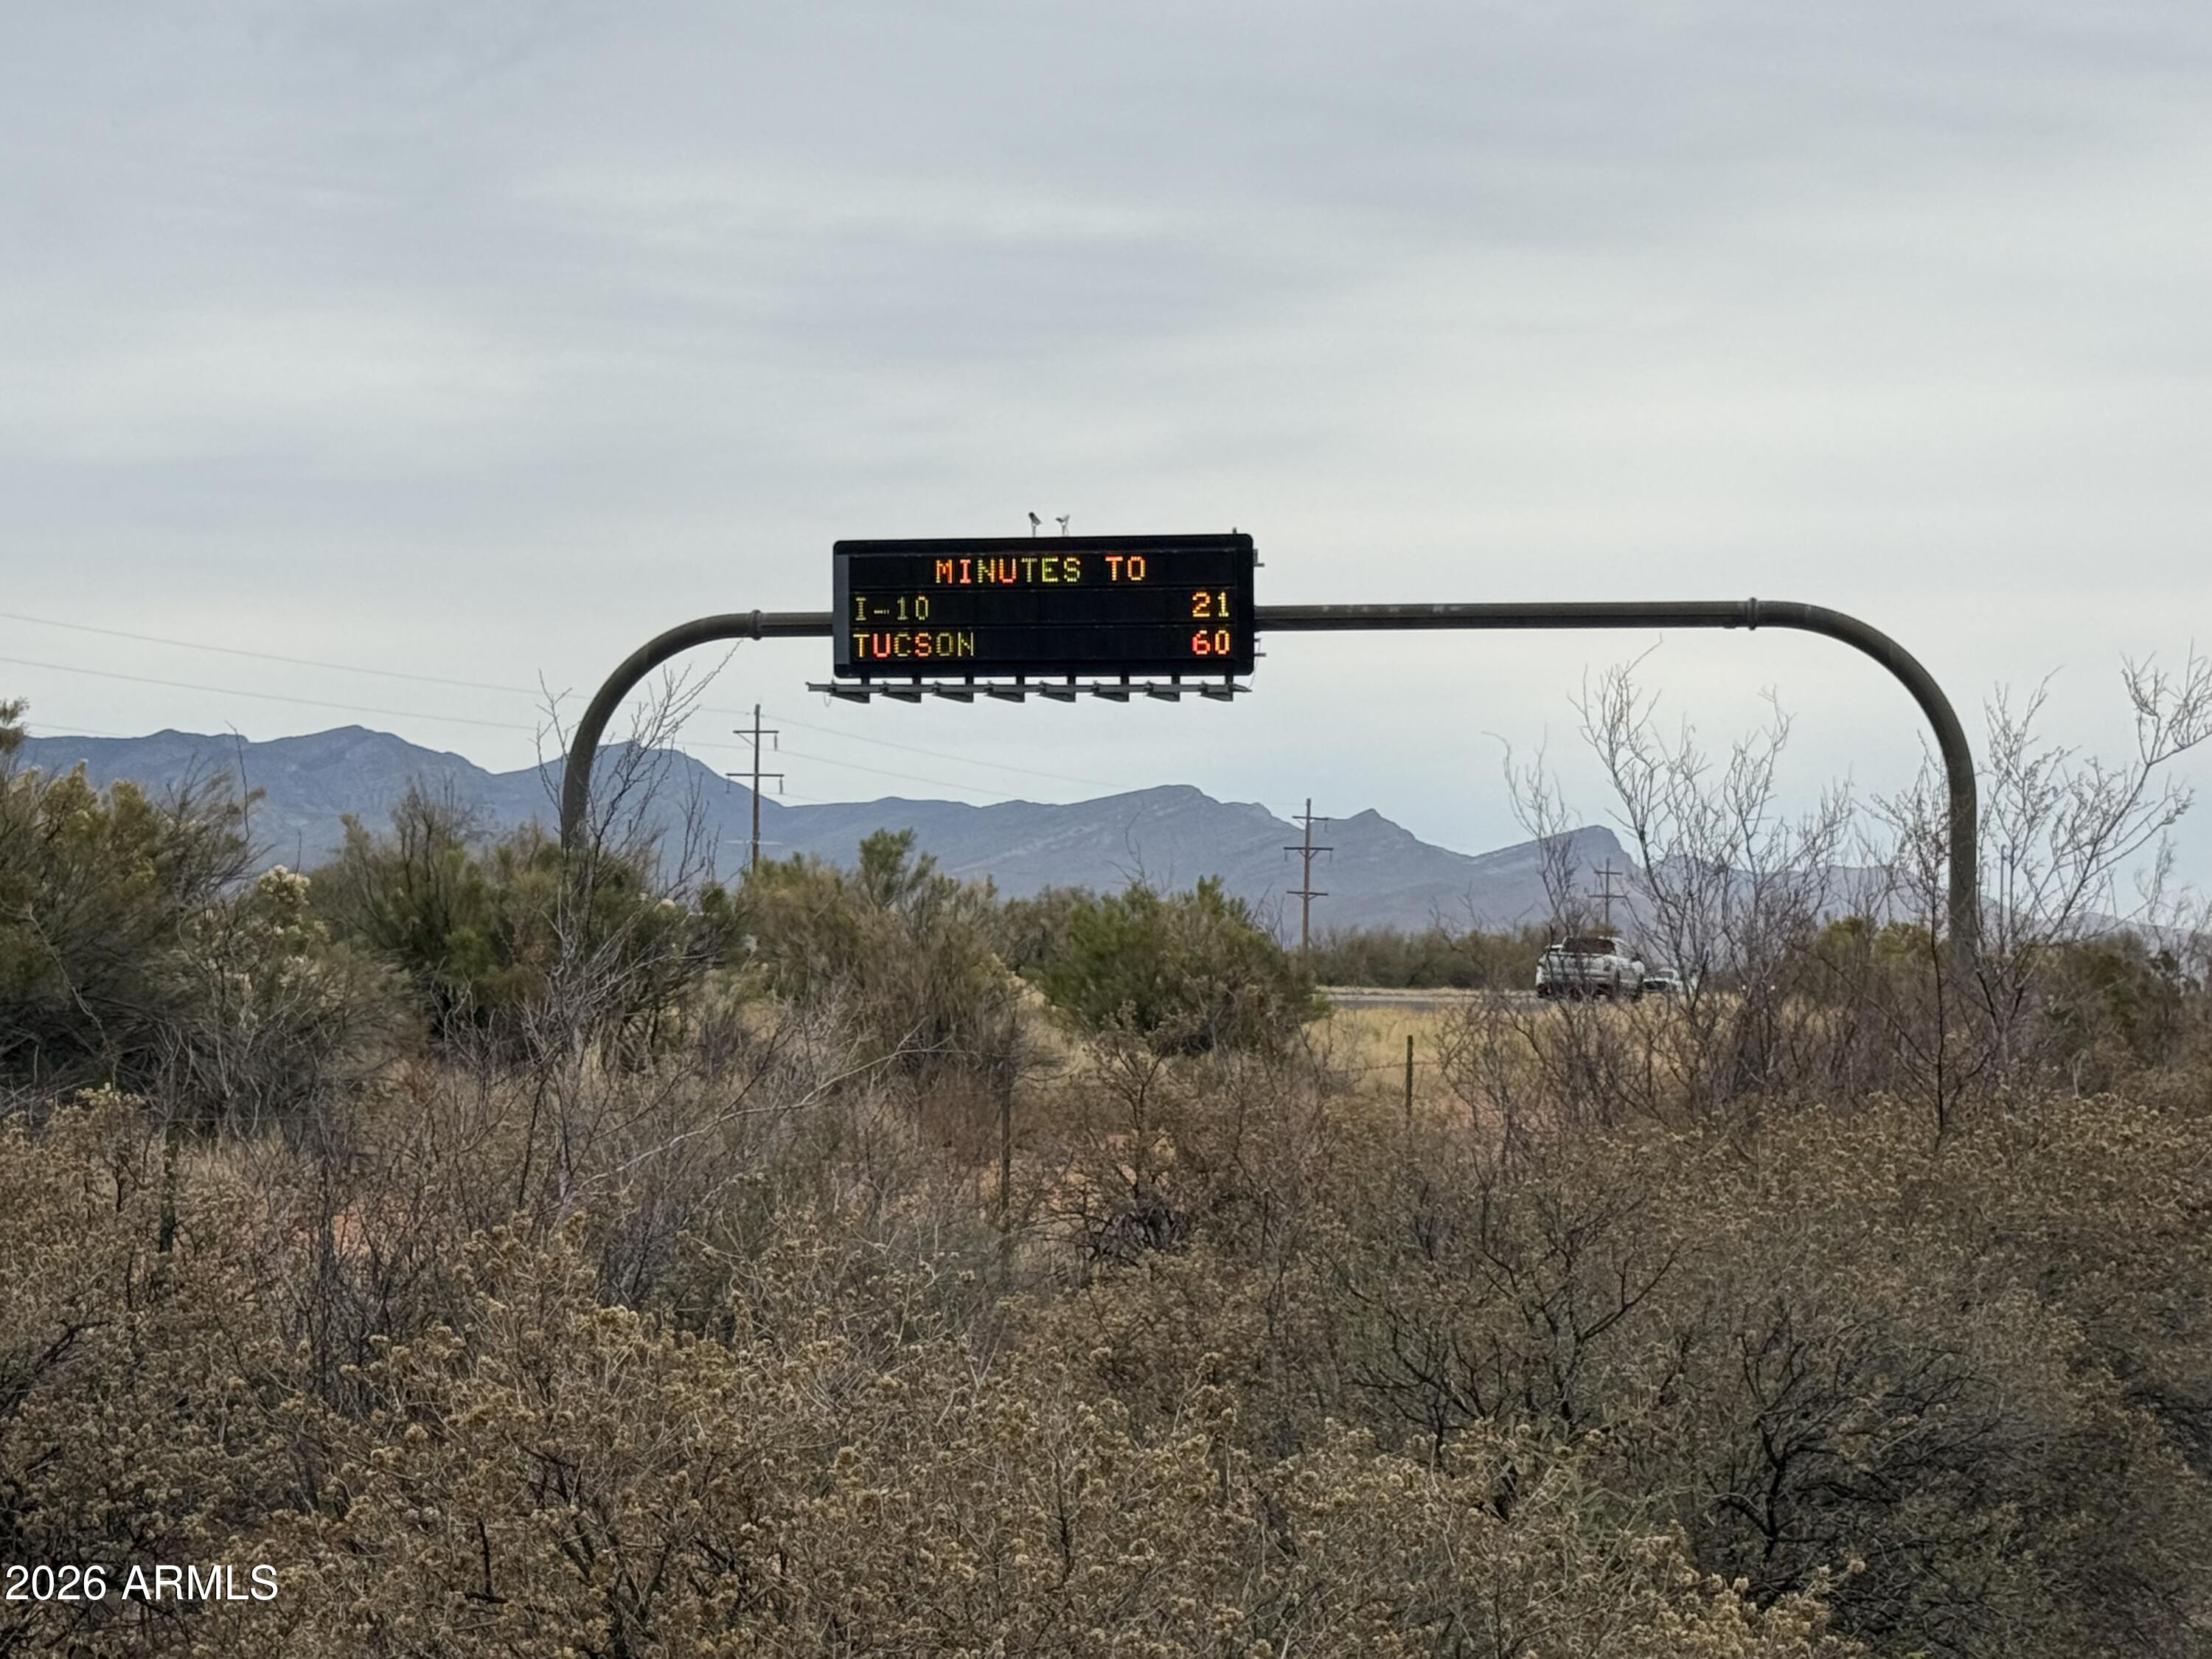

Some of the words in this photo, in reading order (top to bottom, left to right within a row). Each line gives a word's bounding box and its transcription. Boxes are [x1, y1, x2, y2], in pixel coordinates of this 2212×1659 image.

[934, 557, 1081, 584] MINUTES
[1105, 555, 1146, 581] TO
[855, 595, 930, 622] I-10
[1192, 591, 1229, 617] 21
[852, 631, 974, 658] TUCSON
[1192, 629, 1231, 655] 60
